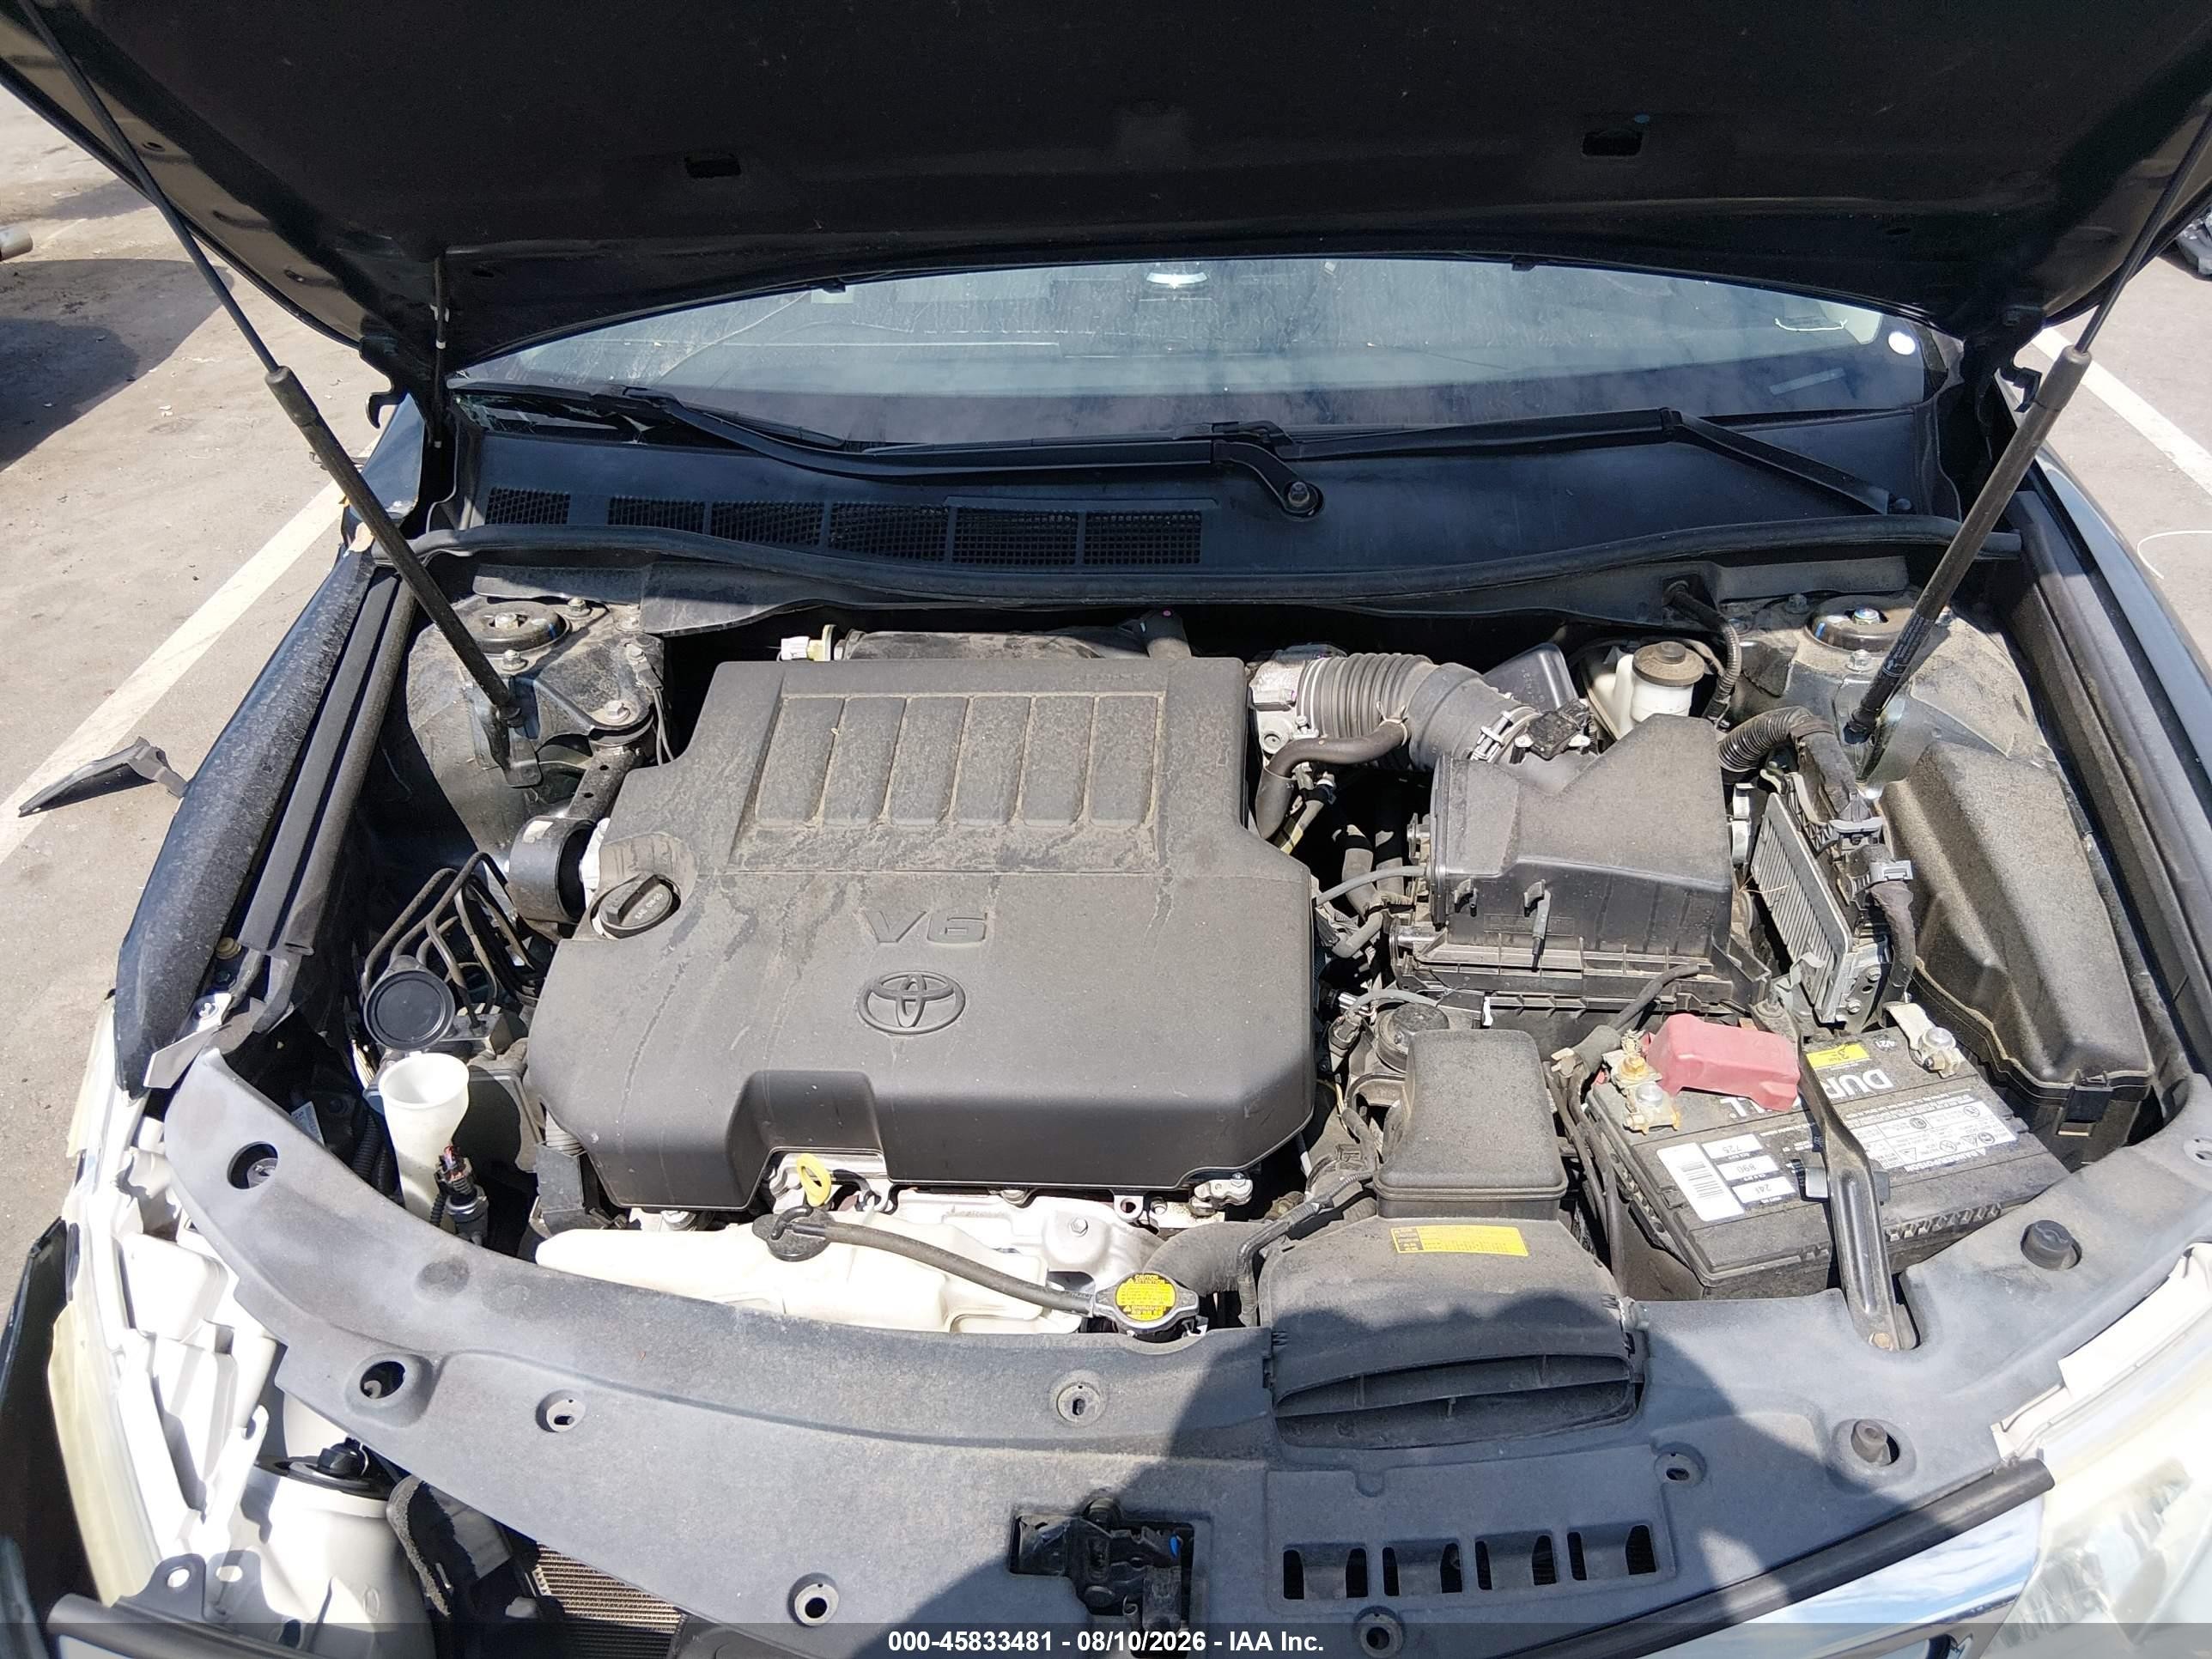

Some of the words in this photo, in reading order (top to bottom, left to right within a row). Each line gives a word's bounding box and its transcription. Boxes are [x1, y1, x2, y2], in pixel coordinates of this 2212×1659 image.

[861, 909, 988, 945] V6
[1721, 1144, 1742, 1155] 725
[1735, 1163, 1757, 1174] 890
